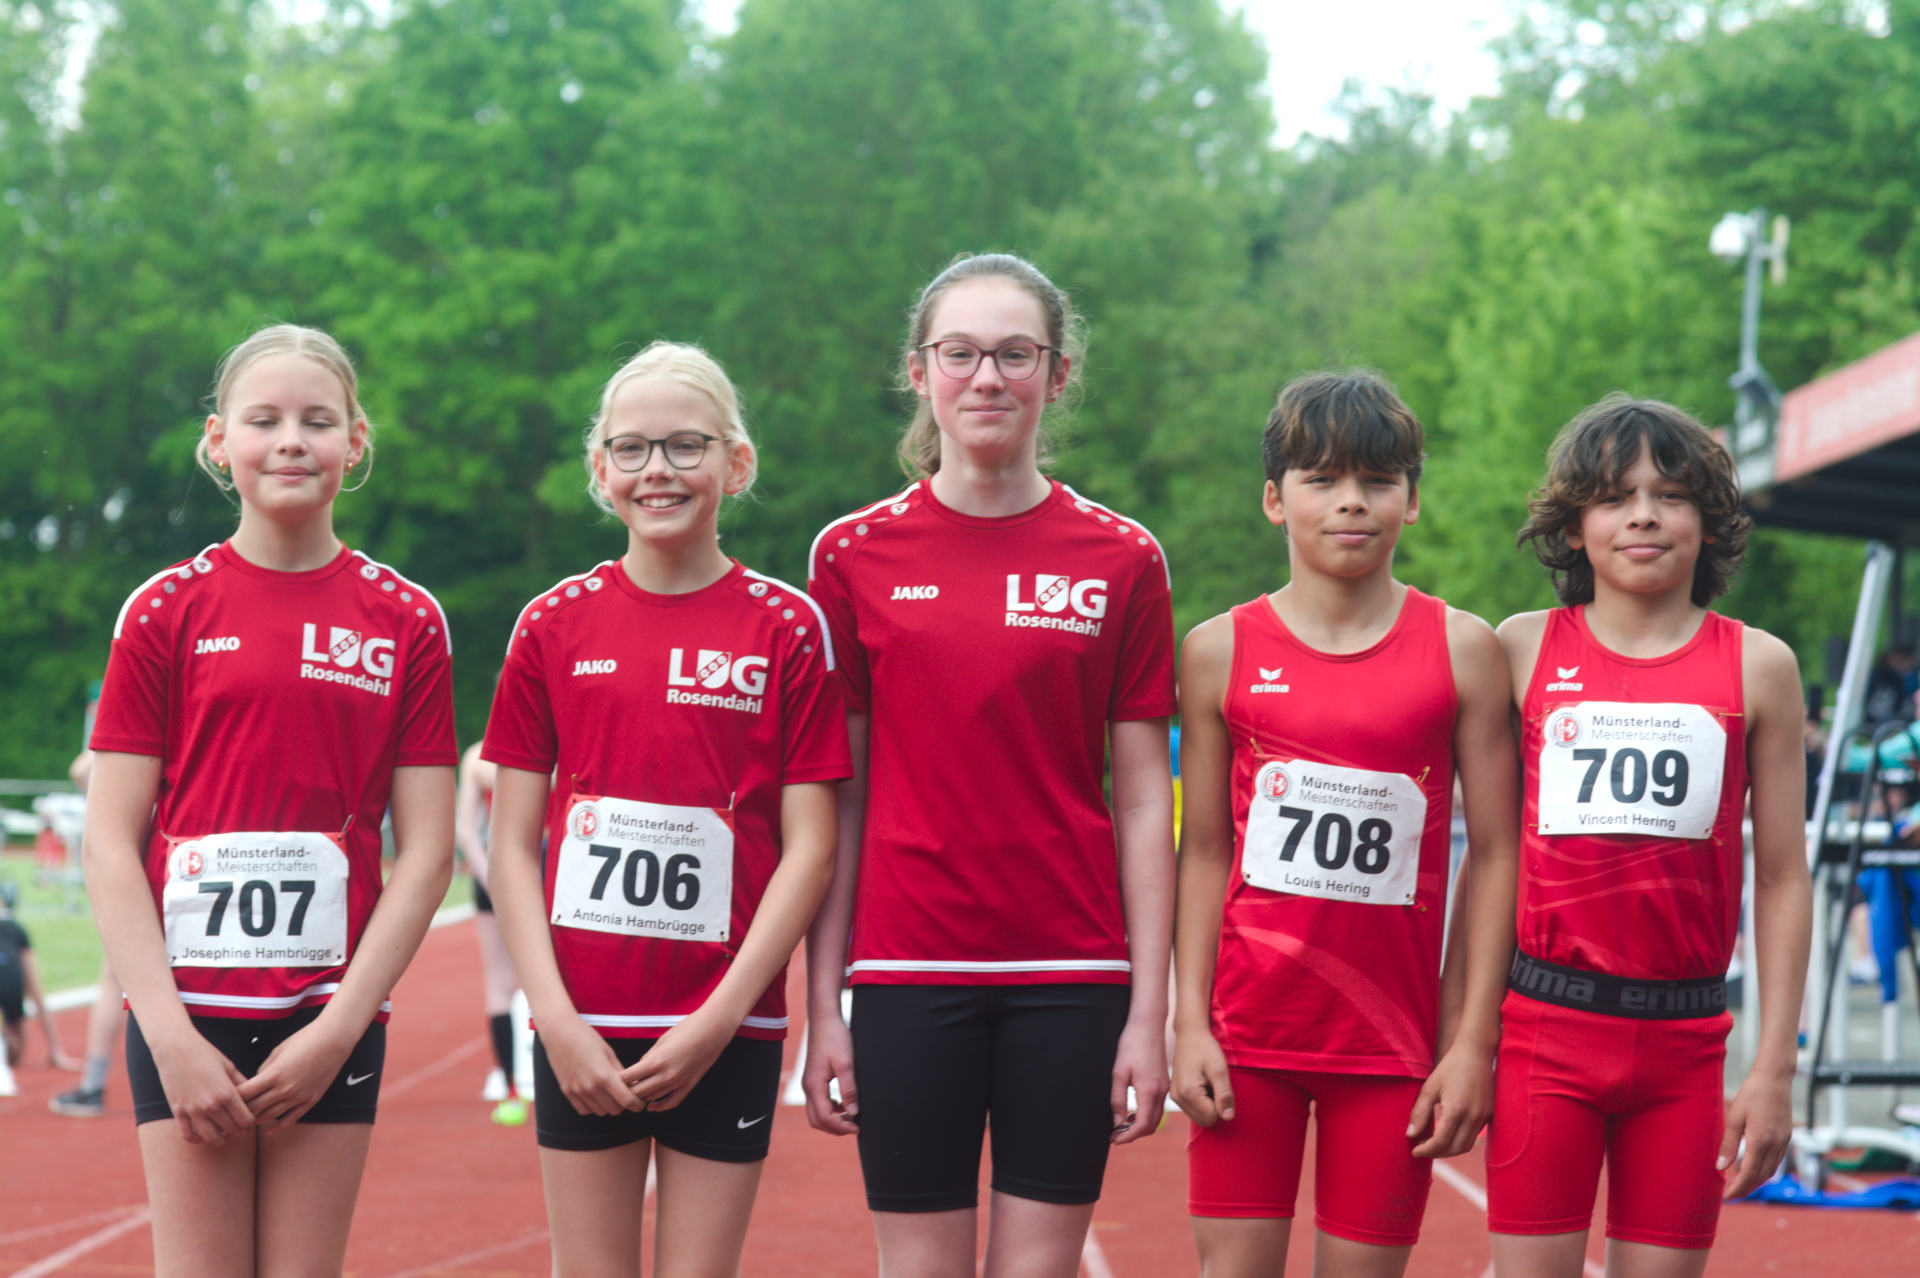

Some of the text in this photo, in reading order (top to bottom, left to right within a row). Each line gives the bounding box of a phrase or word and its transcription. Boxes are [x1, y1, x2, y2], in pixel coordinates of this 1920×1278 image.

[890, 585, 939, 600] JAKO
[1005, 612, 1102, 637] Rosendahl
[195, 636, 241, 654] JAKO
[572, 659, 617, 676] JAKO
[300, 663, 391, 696] Rosendahl
[1250, 682, 1290, 694] erima
[1545, 680, 1584, 692] erima
[667, 688, 762, 714] Rosendahl
[1592, 716, 1686, 729] Münsterland-
[1591, 729, 1693, 744] Meisterschaften
[1300, 775, 1393, 798] Münsterland-
[1572, 747, 1690, 807] 709
[1298, 789, 1398, 813] Meisterschaften
[609, 813, 701, 833] Münsterland-
[1578, 813, 1677, 831] Vincent Hering
[607, 826, 705, 848] Meisterschaften
[1278, 805, 1393, 875] 708
[216, 847, 311, 860] Münsterland-
[216, 860, 318, 873] Meisterschaften
[588, 843, 702, 911] 706
[1284, 873, 1371, 898] Louis Hering
[197, 879, 316, 938] 707
[572, 908, 706, 936] Antonia Hambrügge
[181, 946, 332, 961] Josephine Hambrügge
[1510, 957, 1727, 1011] rima erima
